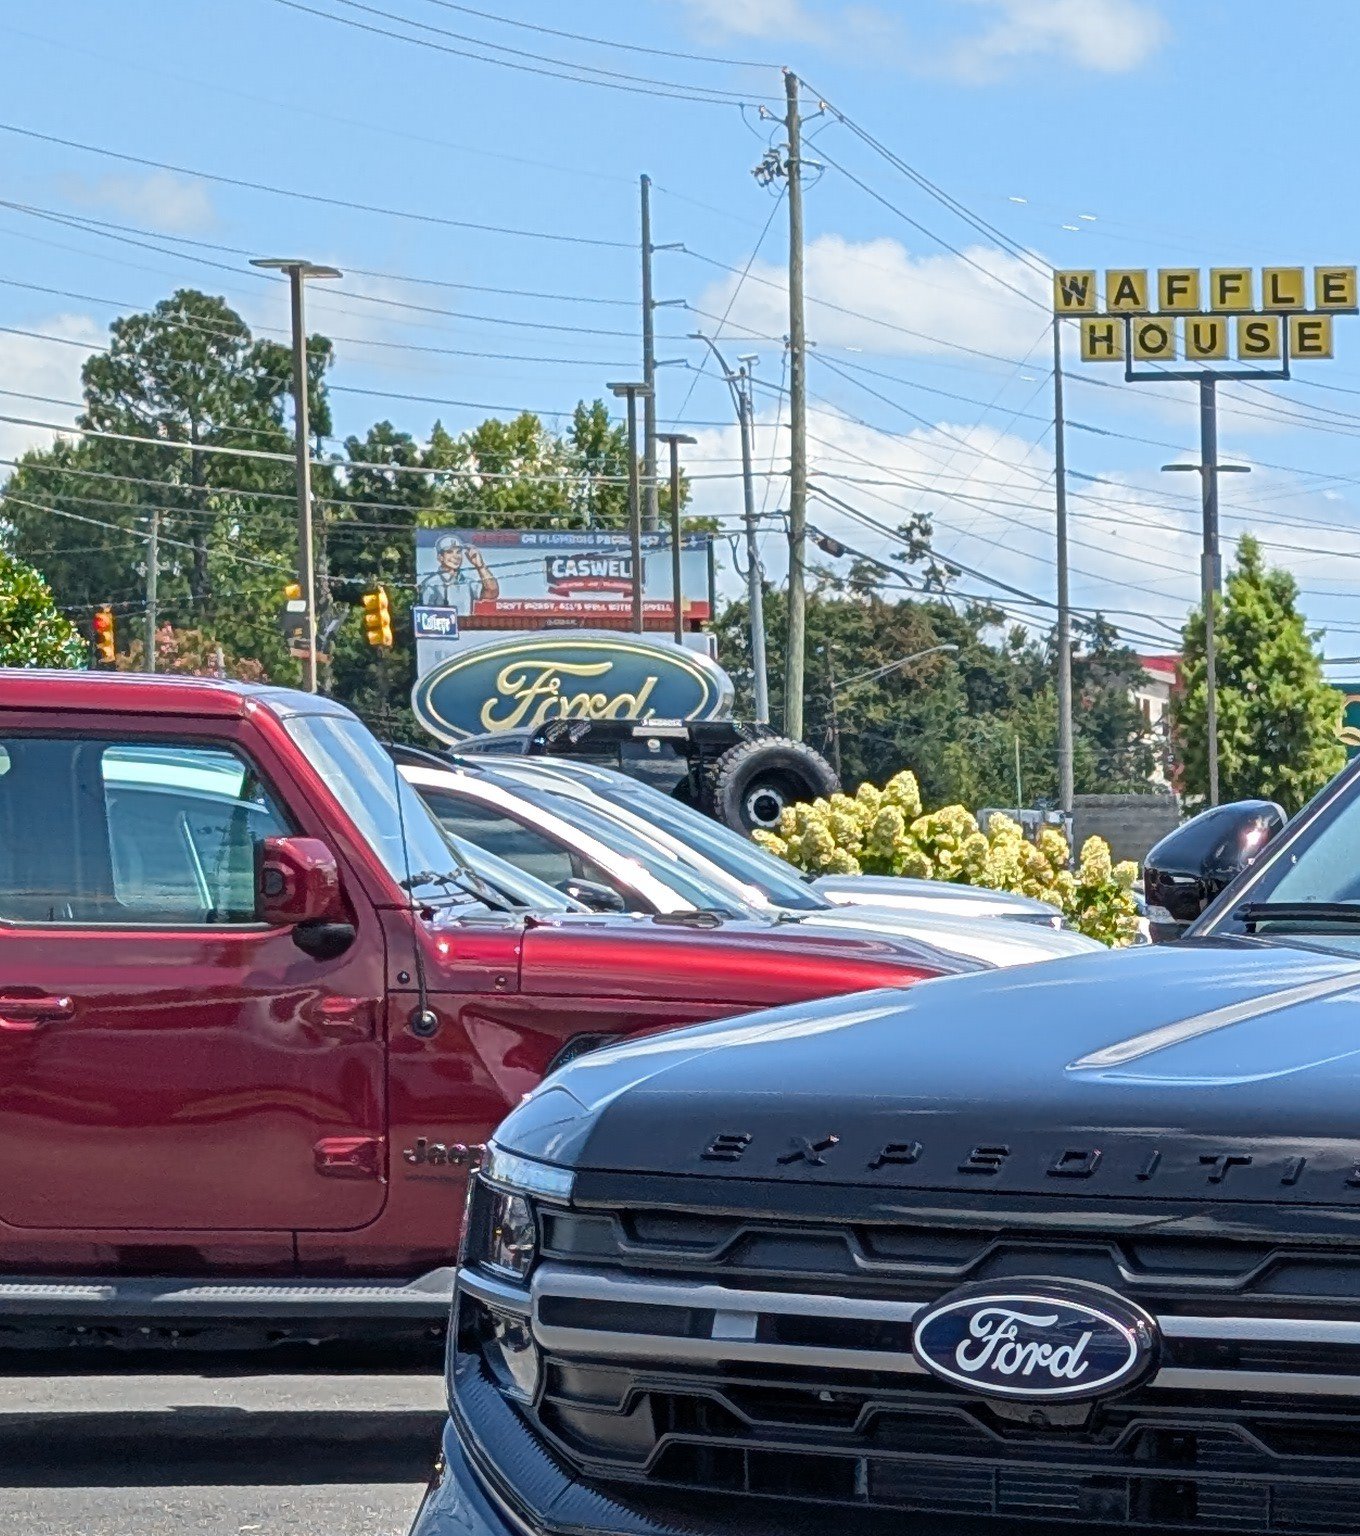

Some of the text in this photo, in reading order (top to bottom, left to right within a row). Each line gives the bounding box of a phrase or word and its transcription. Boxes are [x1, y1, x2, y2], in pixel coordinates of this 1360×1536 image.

[1059, 272, 1348, 307] WAFFLE
[1088, 322, 1323, 355] HOUSE
[551, 559, 635, 579] CASWEL
[481, 659, 658, 732] Ford
[955, 1307, 1093, 1380] Ford
